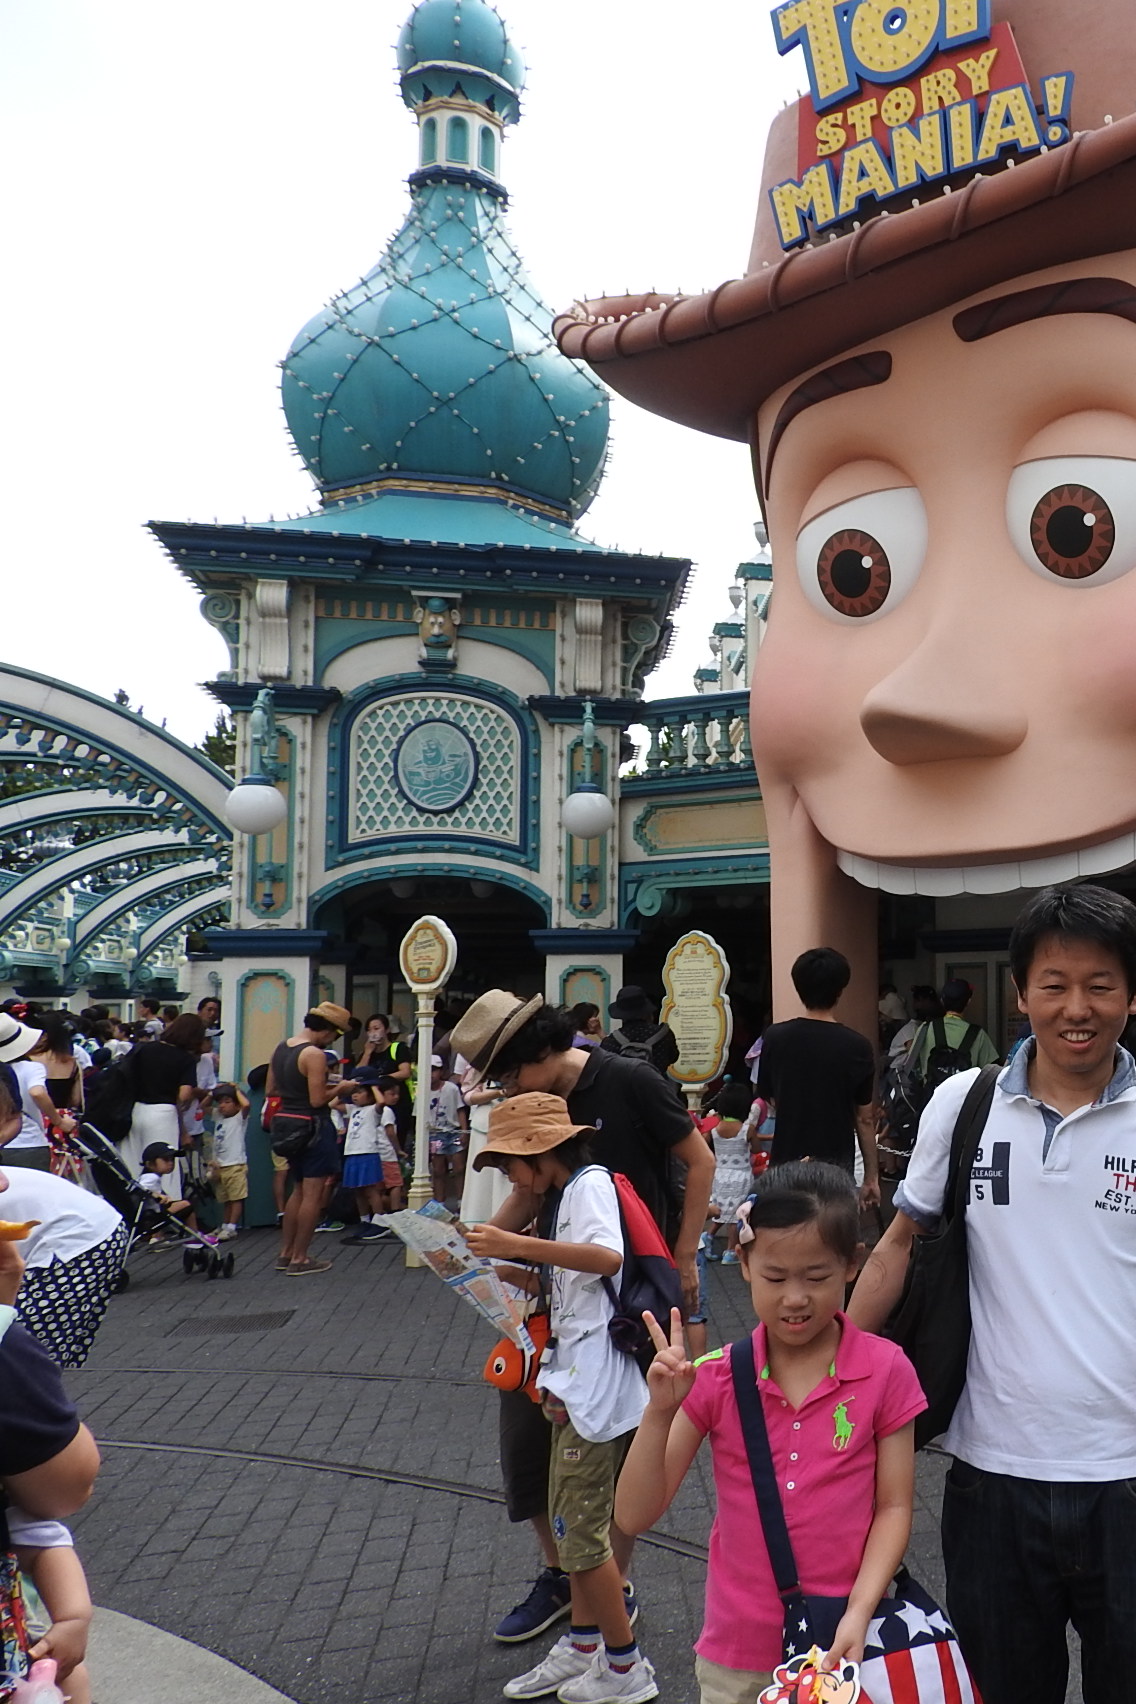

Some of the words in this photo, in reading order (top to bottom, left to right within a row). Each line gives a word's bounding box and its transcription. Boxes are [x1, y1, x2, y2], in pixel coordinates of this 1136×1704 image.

[816, 48, 998, 157] STORY
[769, 71, 1075, 250] MANIA!
[975, 1169, 1003, 1178] LEAGUE
[1095, 1200, 1120, 1212] NEW
[1104, 1189, 1133, 1207] EST.
